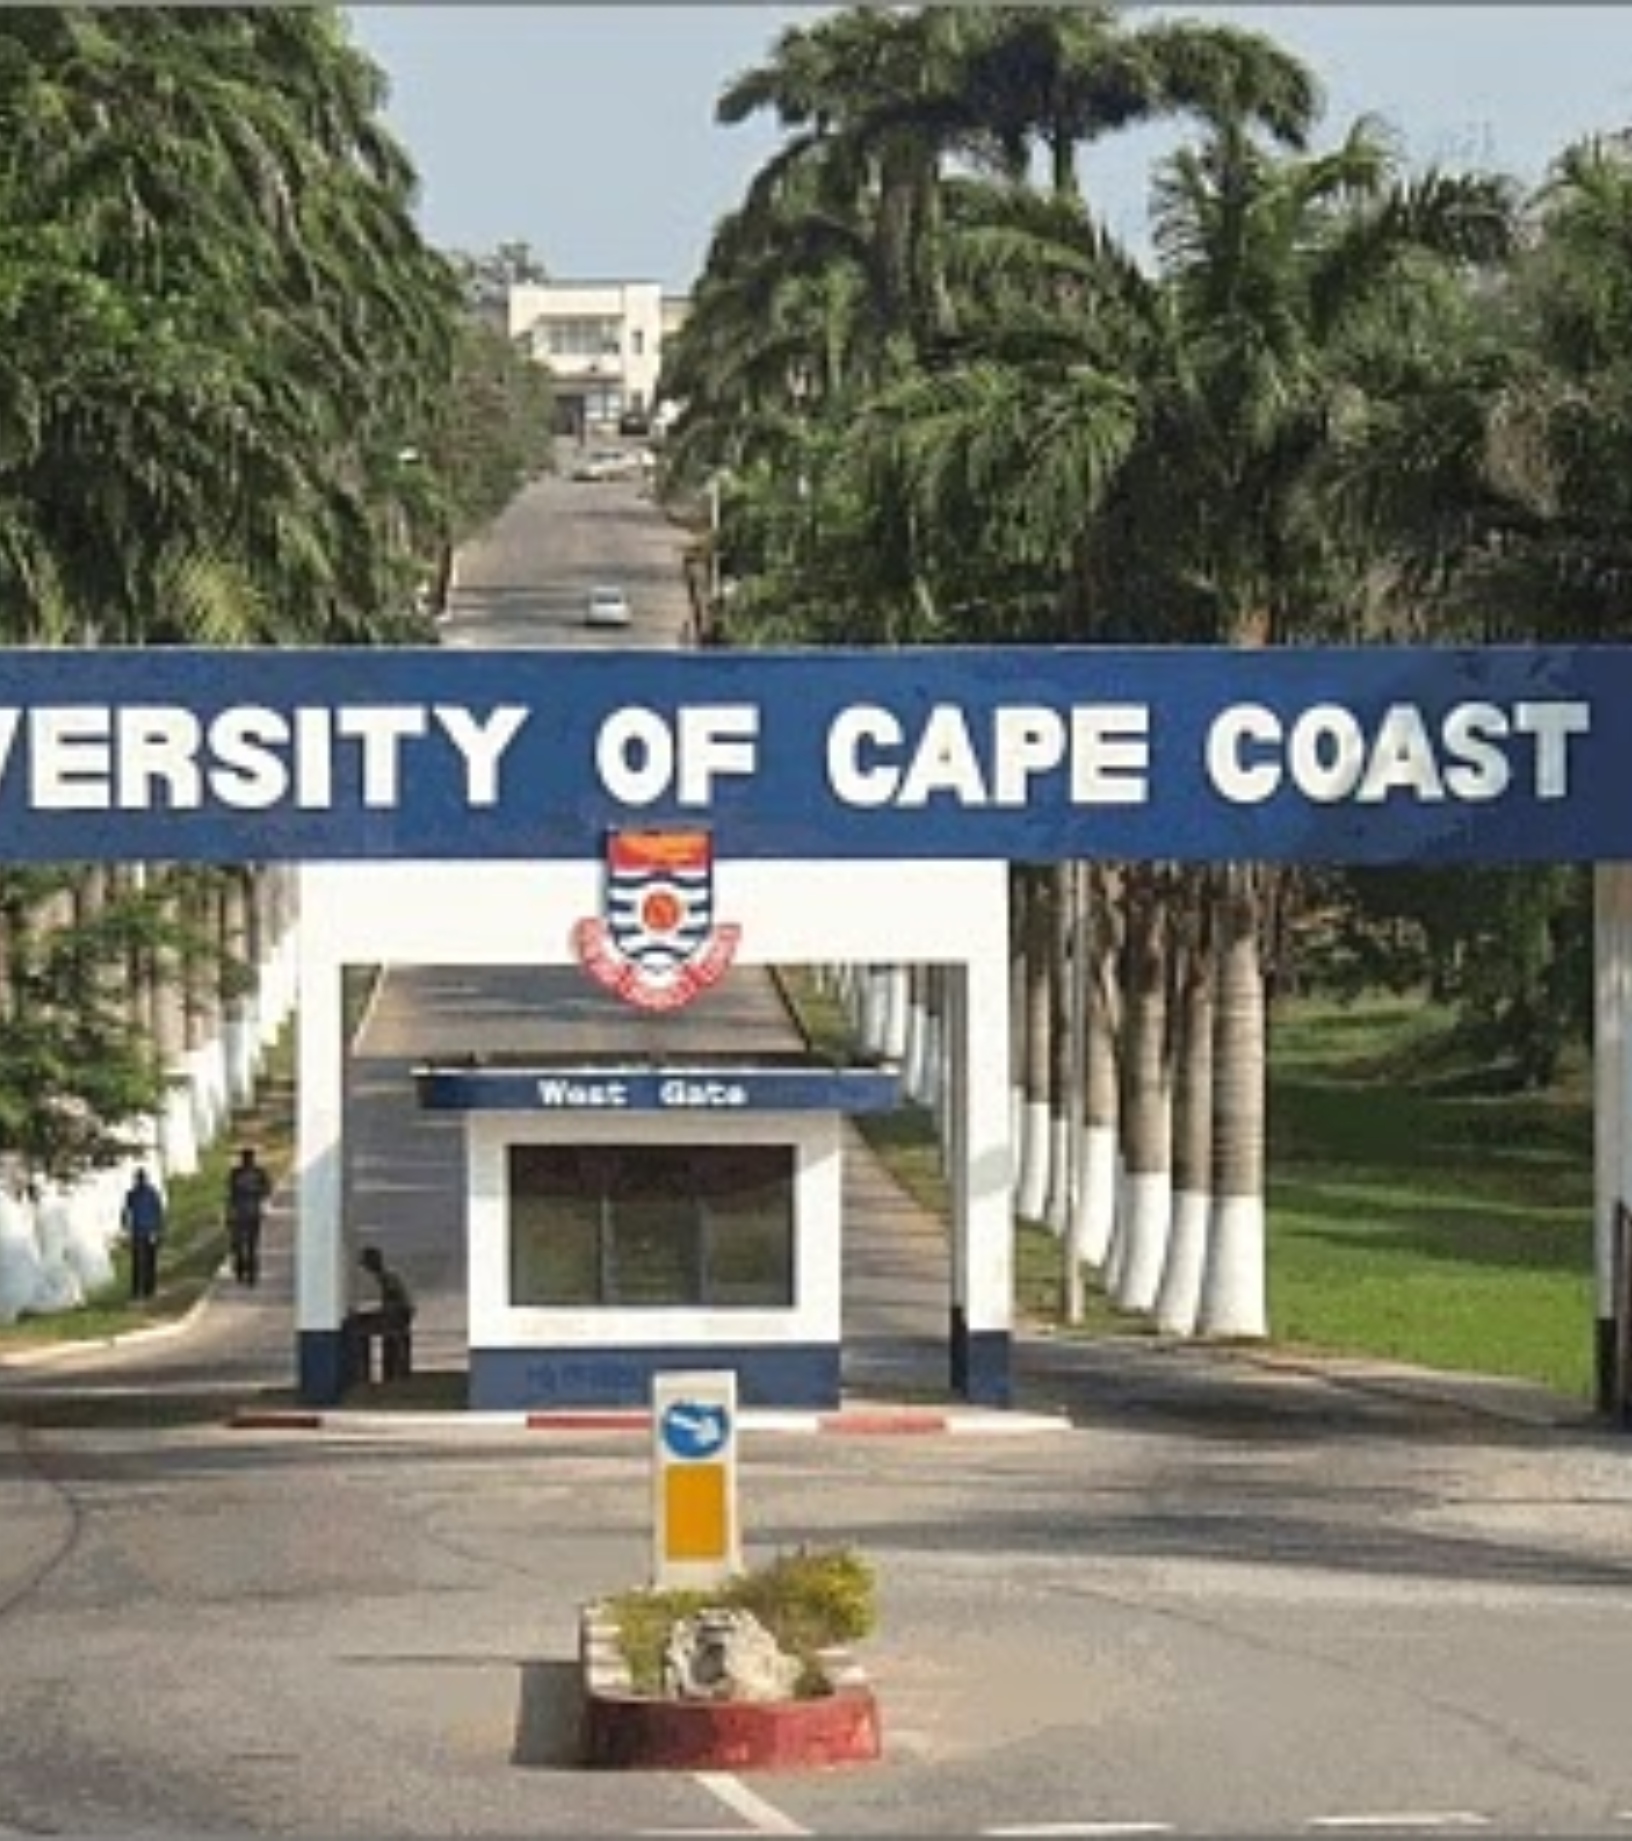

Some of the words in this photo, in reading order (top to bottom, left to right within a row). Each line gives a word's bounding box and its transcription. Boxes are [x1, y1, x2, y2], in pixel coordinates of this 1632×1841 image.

[597, 705, 758, 806] OF
[828, 705, 1148, 807] CAPE
[1207, 703, 1588, 803] COAST
[537, 1079, 627, 1106] West
[659, 1079, 748, 1106] Gate
